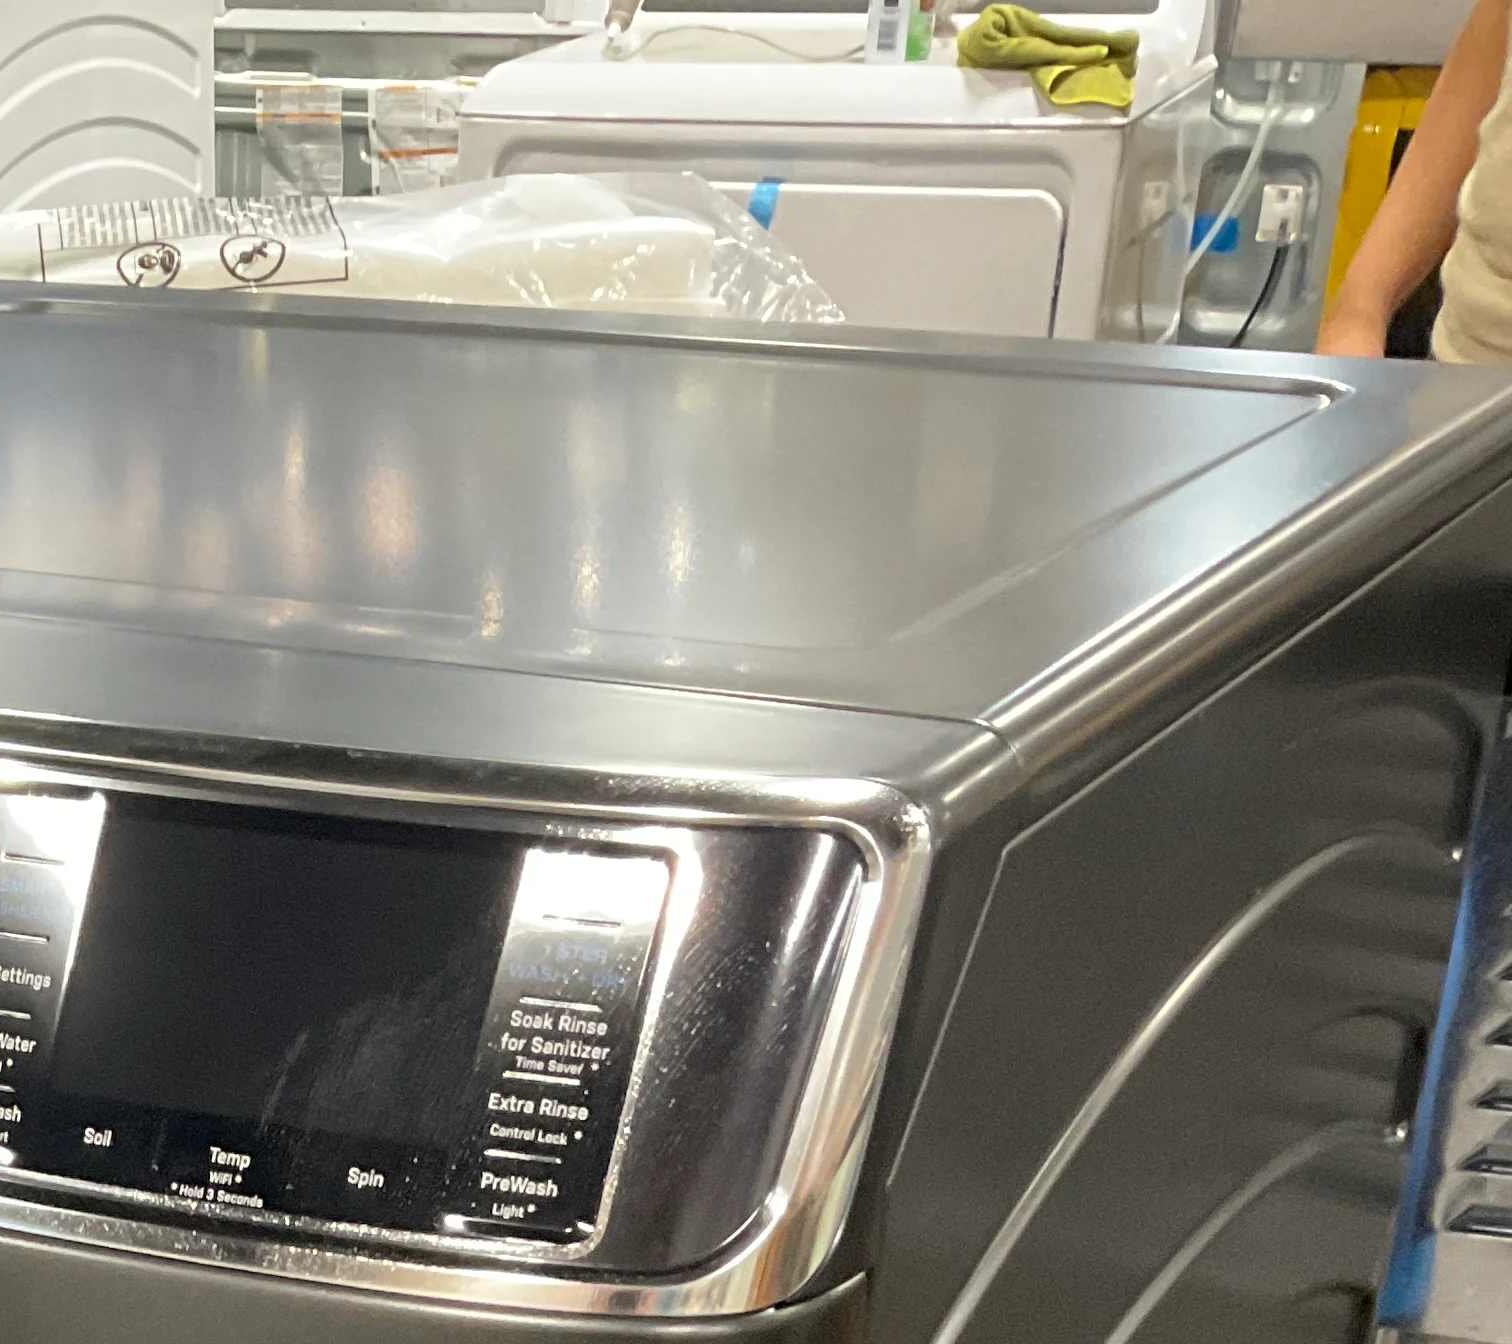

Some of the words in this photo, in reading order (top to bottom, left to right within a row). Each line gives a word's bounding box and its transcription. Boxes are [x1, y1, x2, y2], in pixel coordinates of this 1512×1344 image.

[510, 1010, 554, 1031] Soak
[558, 1014, 608, 1037] Rinse
[501, 1032, 527, 1051] for
[530, 1036, 610, 1062] Sanitizer
[515, 1055, 545, 1071] Time
[547, 1060, 584, 1076] Saver
[488, 1092, 535, 1115] Extra
[539, 1098, 589, 1122] Rinse
[83, 1126, 113, 1148] Soil
[489, 1123, 536, 1142] Control
[537, 1130, 568, 1146] Lock
[209, 1146, 251, 1170] Temp
[348, 1166, 385, 1189] Spin
[481, 1171, 559, 1199] PreWash
[179, 1184, 204, 1200] Hold
[206, 1188, 214, 1201] 3
[216, 1189, 264, 1209] Seconds
[492, 1203, 525, 1220] Light
